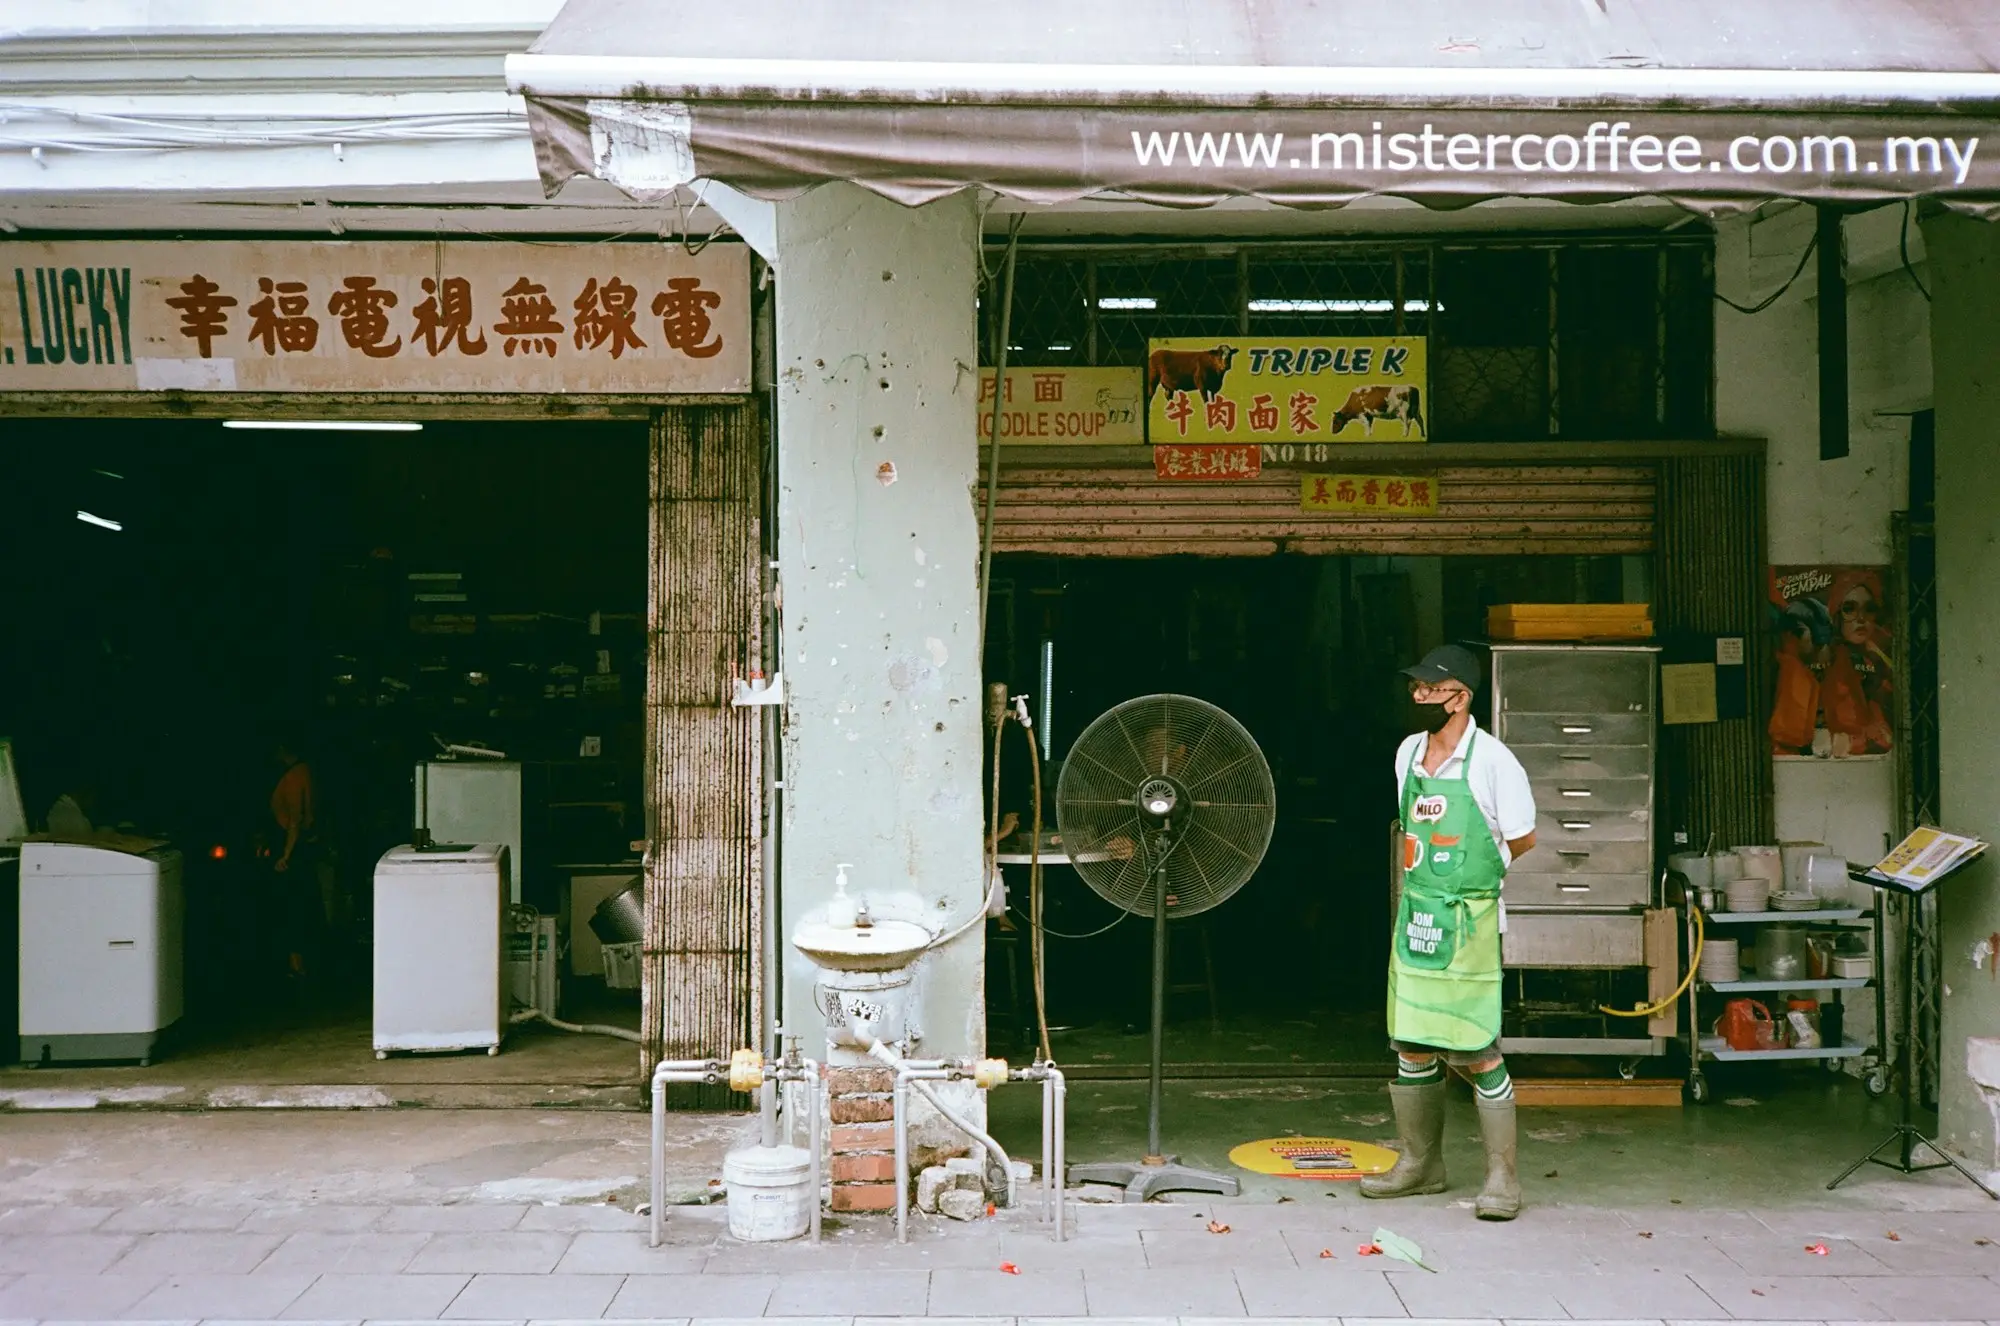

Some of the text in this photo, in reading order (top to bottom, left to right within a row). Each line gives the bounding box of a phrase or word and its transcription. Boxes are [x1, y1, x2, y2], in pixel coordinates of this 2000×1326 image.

[1131, 122, 1979, 184] www.mistercoffee.com.my
[15, 267, 132, 365] LUCKY
[166, 274, 724, 359] 幸福電視無線電
[1249, 348, 1408, 377] TRIPLE K
[978, 412, 1106, 437] OODLE SOUP
[1165, 391, 1320, 435] 牛肉面家
[1263, 444, 1329, 462] NO 18
[1782, 573, 1832, 599] GEMPAK
[1416, 803, 1443, 816] MILO
[1407, 922, 1443, 941] MINUM
[1413, 911, 1434, 927] JOM
[1409, 937, 1437, 954] MILO
